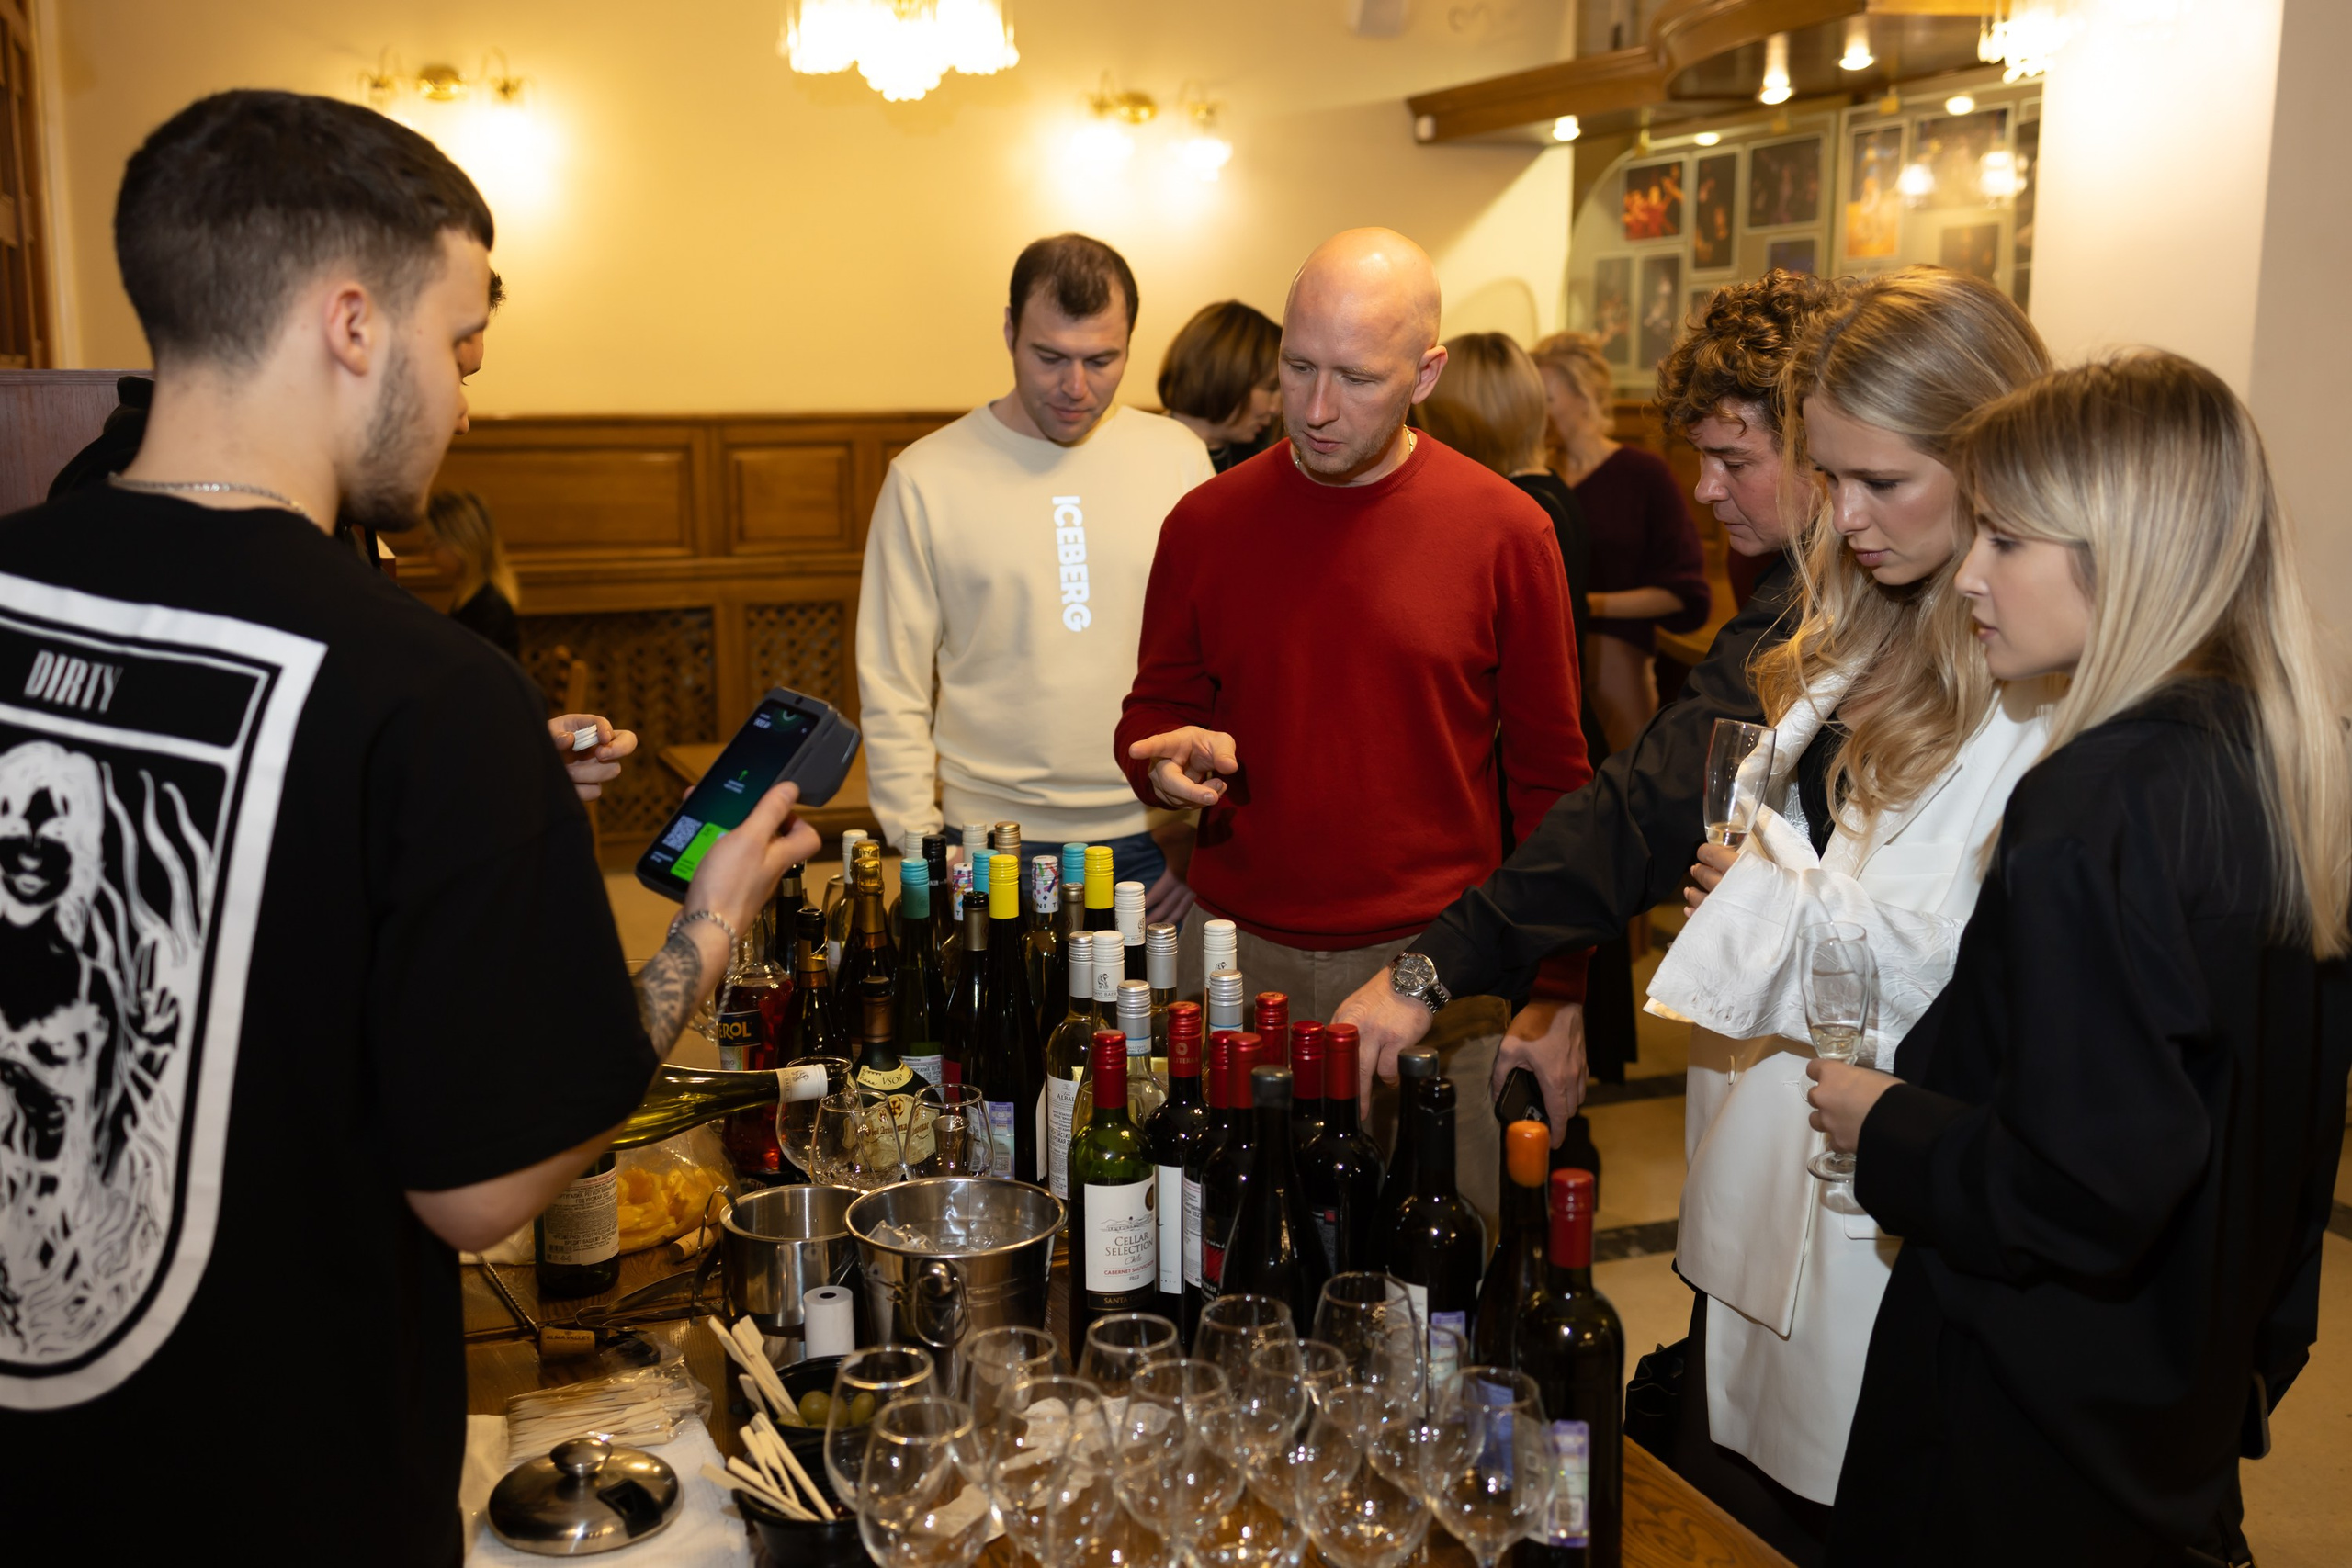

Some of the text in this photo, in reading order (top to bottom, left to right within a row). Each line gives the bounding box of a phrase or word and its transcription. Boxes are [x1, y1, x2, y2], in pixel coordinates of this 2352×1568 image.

[1052, 495, 1091, 632] ICEBERG
[24, 649, 123, 714] DIRTY
[882, 1073, 903, 1086] VSOP
[1114, 1232, 1148, 1246] CELLAR
[1105, 1237, 1153, 1256] SELECTION
[1124, 1254, 1142, 1265] Chile
[1132, 1259, 1154, 1272] SAUVIGNON
